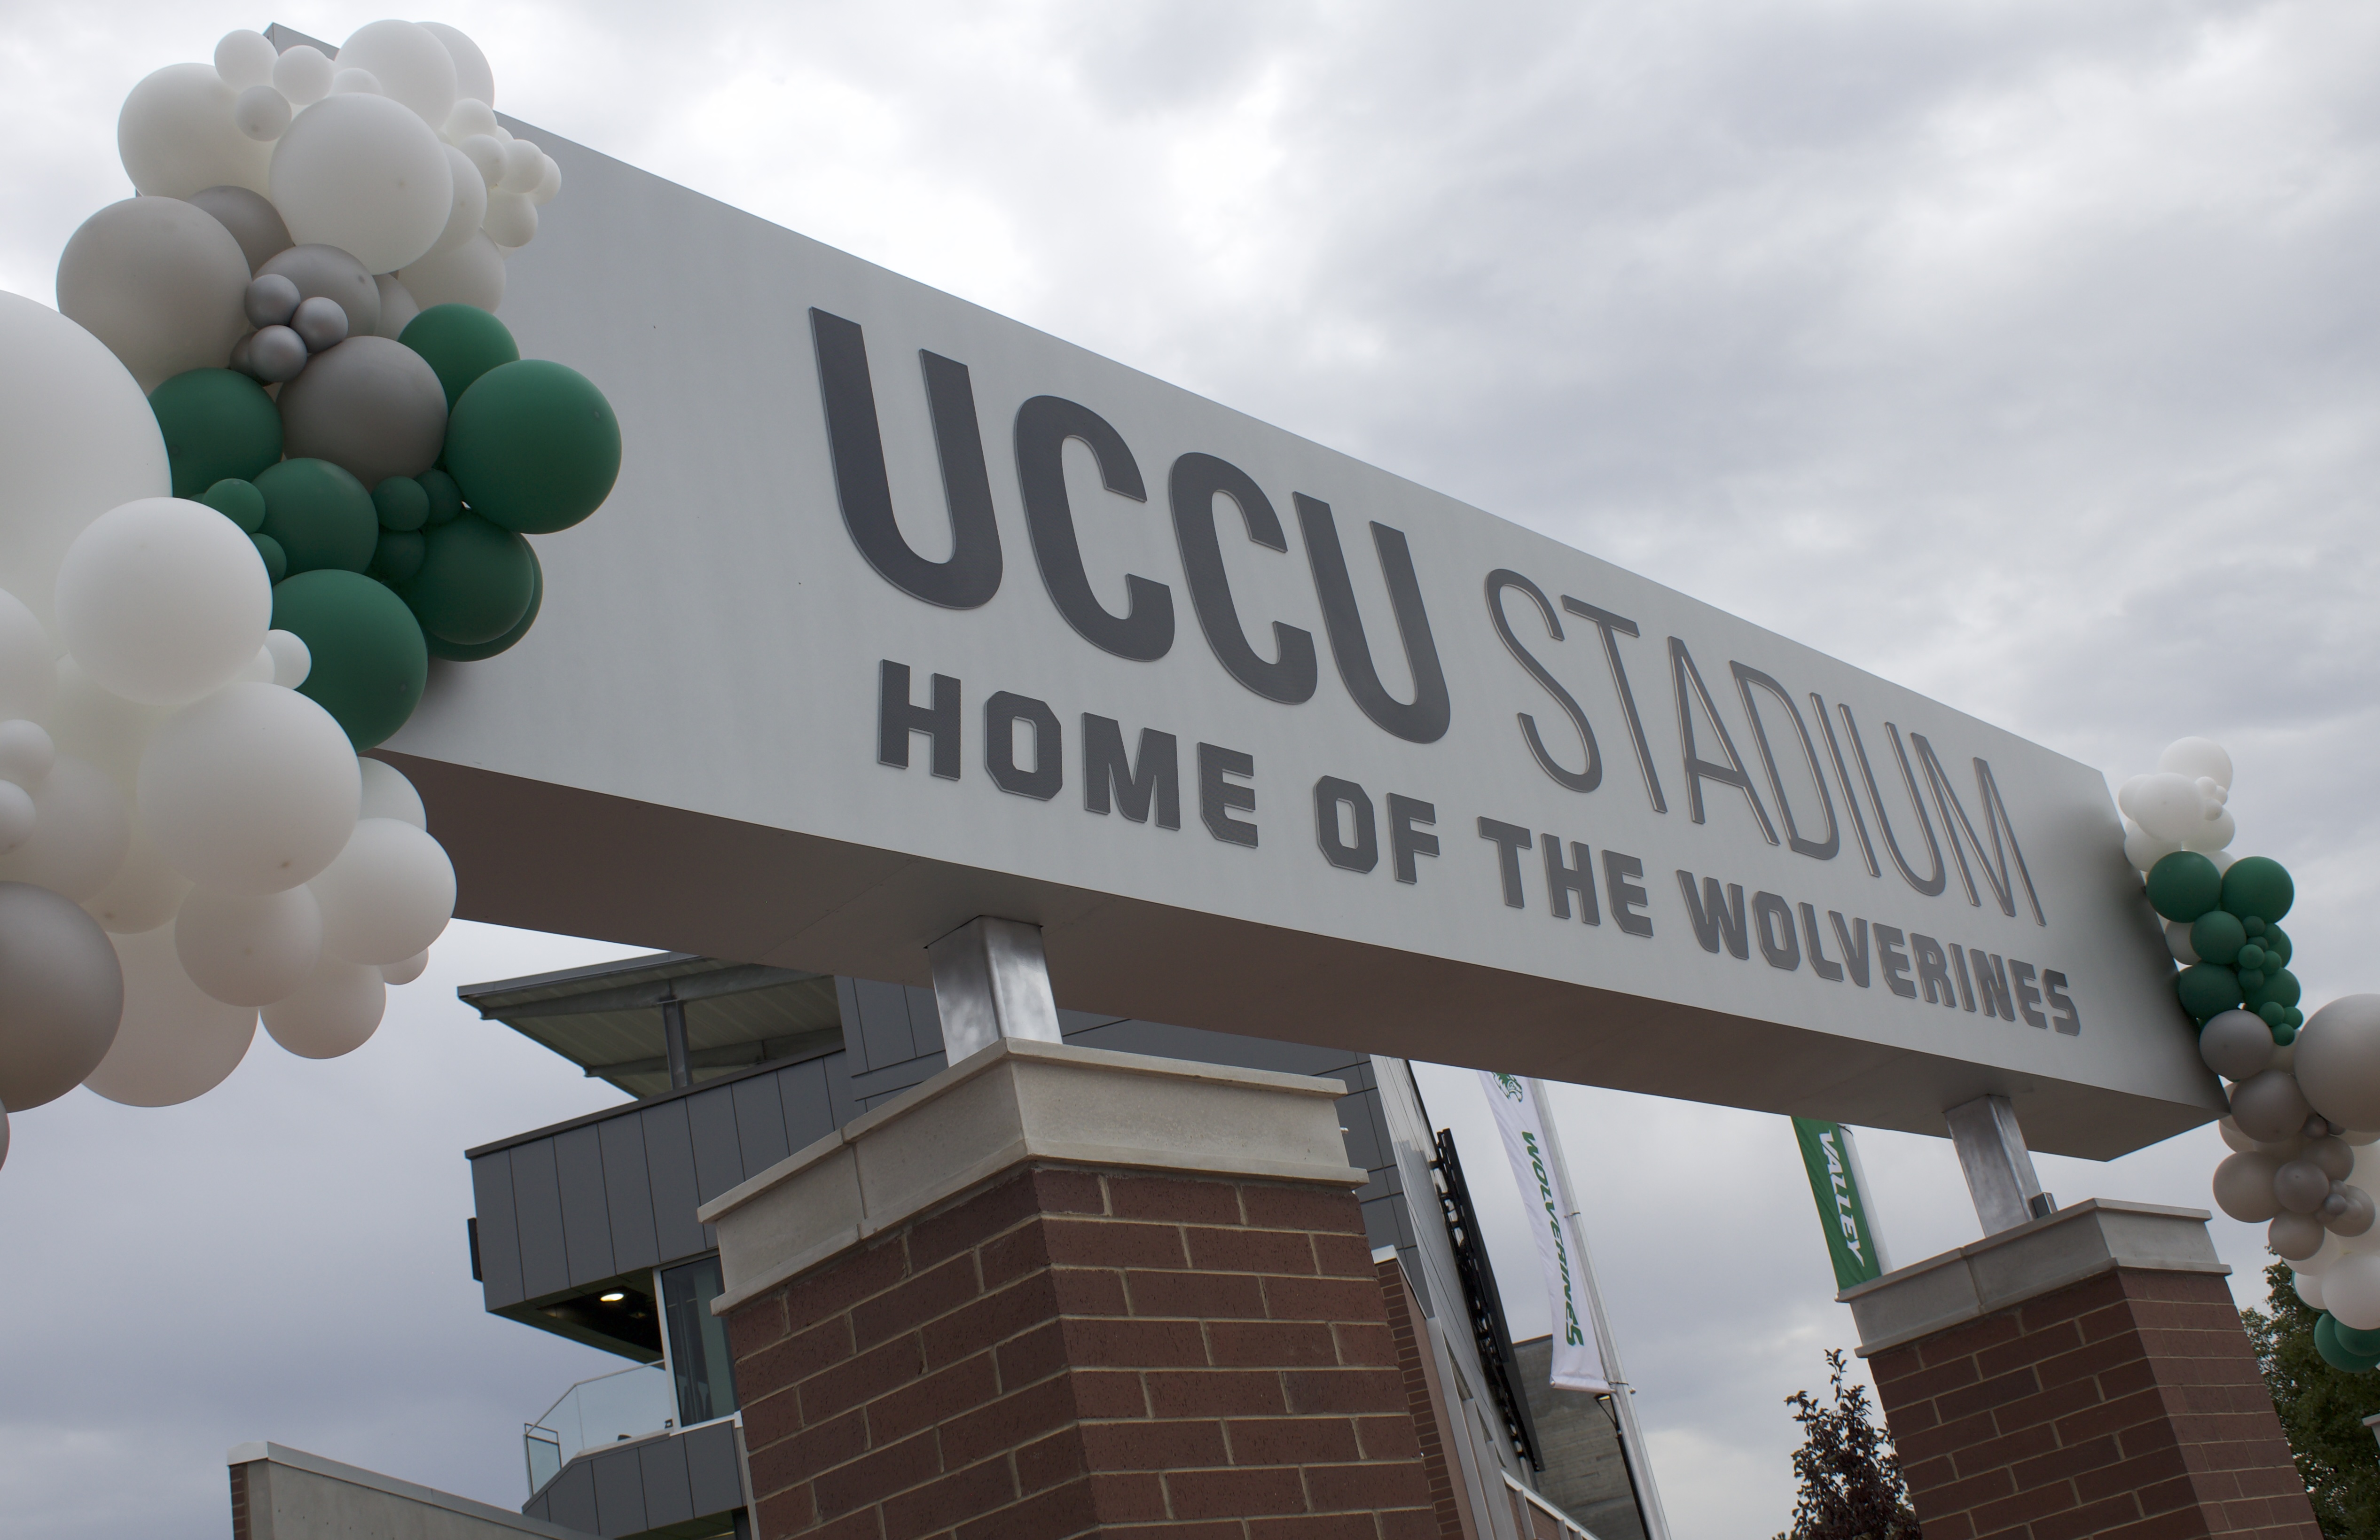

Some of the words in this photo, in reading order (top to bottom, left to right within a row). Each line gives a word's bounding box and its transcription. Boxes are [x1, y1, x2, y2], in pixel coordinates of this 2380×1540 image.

[809, 307, 1450, 743] UCCU
[1485, 569, 2046, 926] STADIUM
[878, 659, 1260, 848] HOME
[1314, 775, 1440, 883] OF
[1478, 815, 1653, 938] THE
[1677, 869, 2081, 1036] WOLVERINES
[1522, 1131, 1583, 1346] WOLVERINES
[1819, 1130, 1864, 1267] VALLEY
